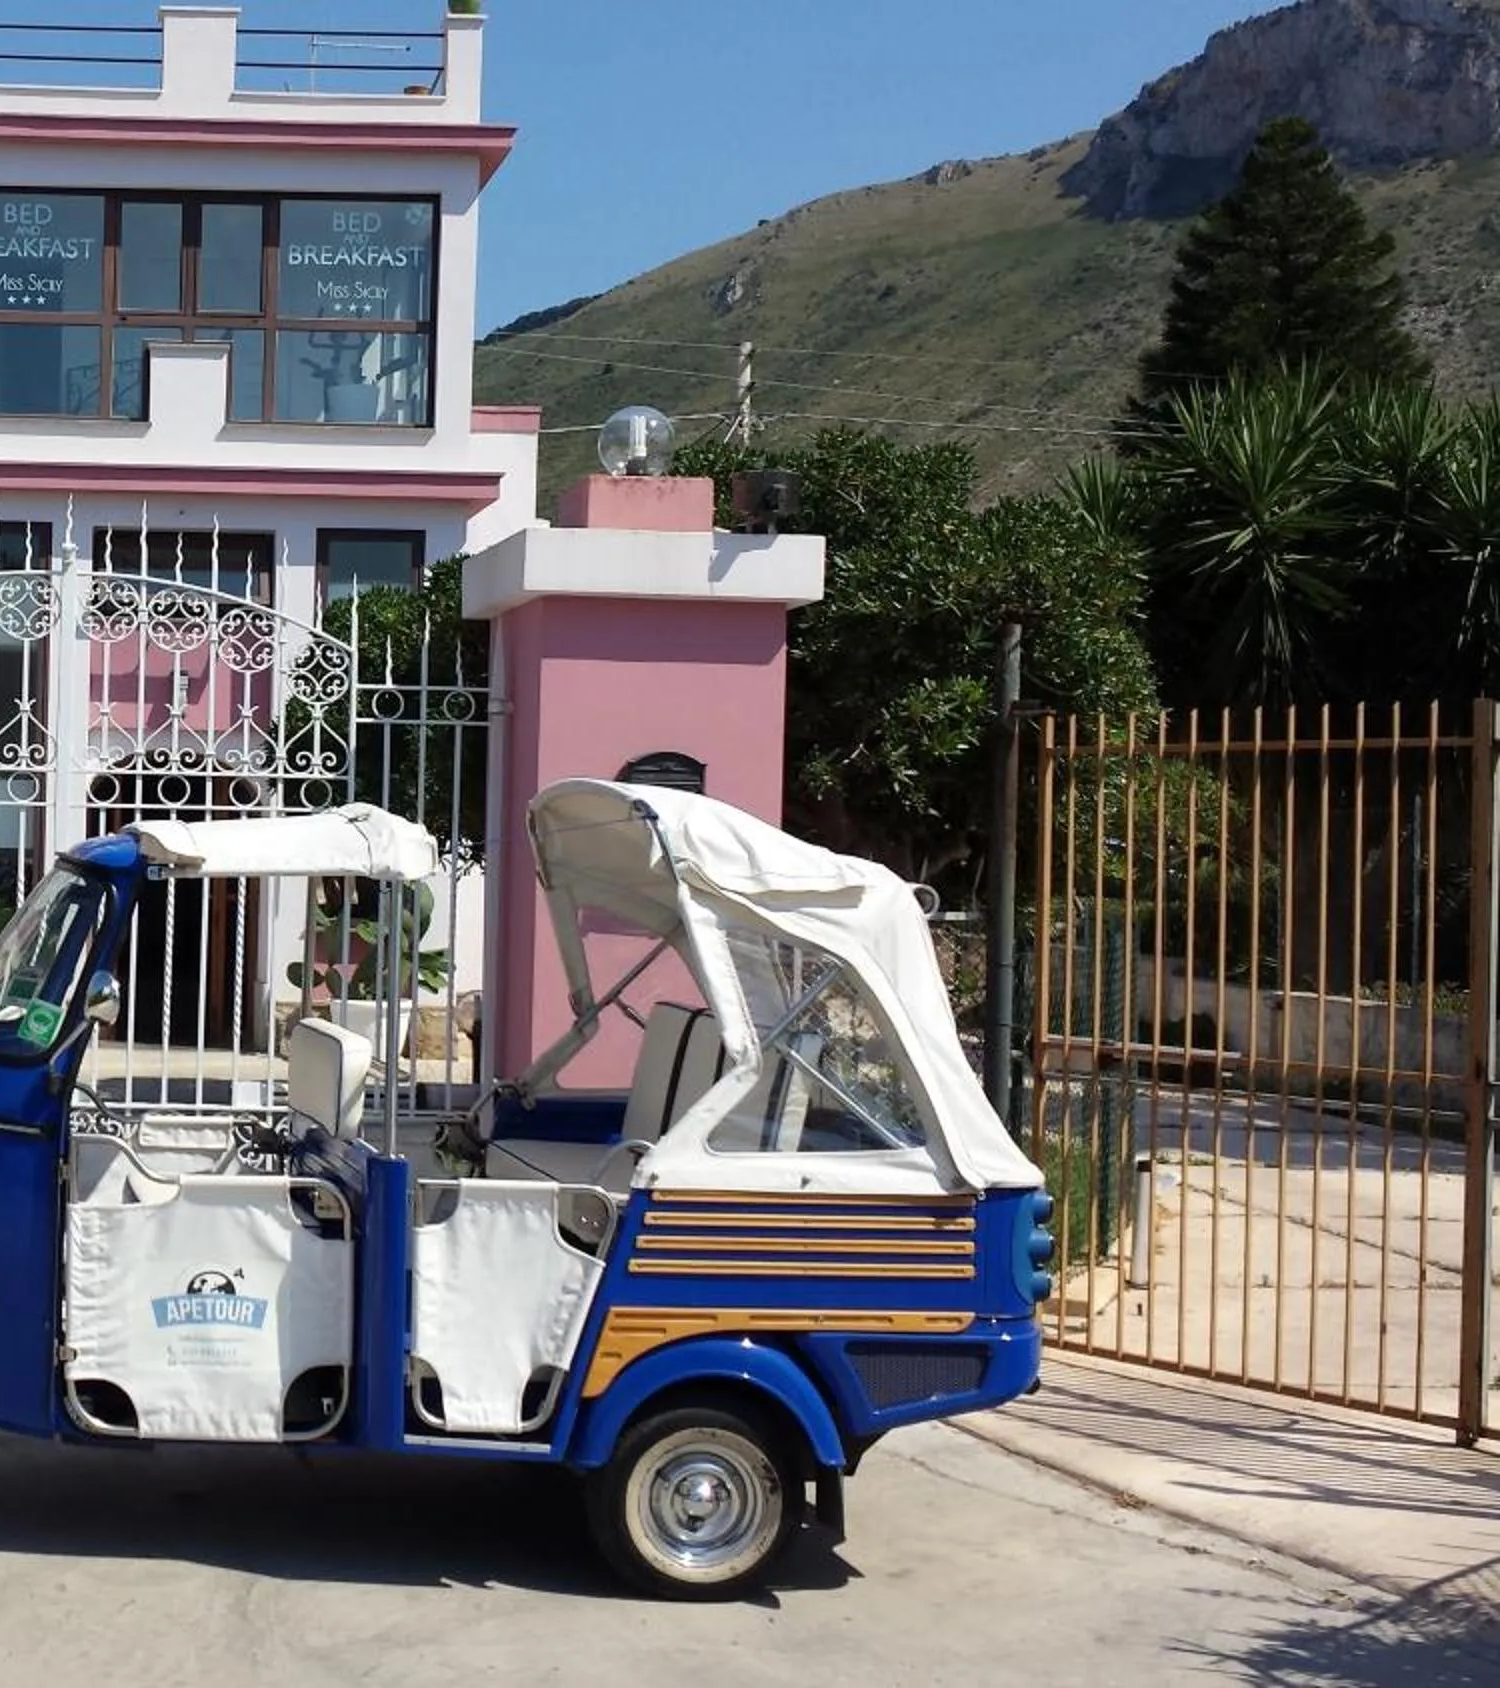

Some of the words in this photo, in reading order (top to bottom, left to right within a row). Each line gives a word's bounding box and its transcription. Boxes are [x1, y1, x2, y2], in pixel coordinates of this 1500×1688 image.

[4, 203, 53, 225] BED
[333, 211, 381, 233] BED
[288, 244, 424, 268] BREAKFAST
[166, 1297, 255, 1325] APETOUR
